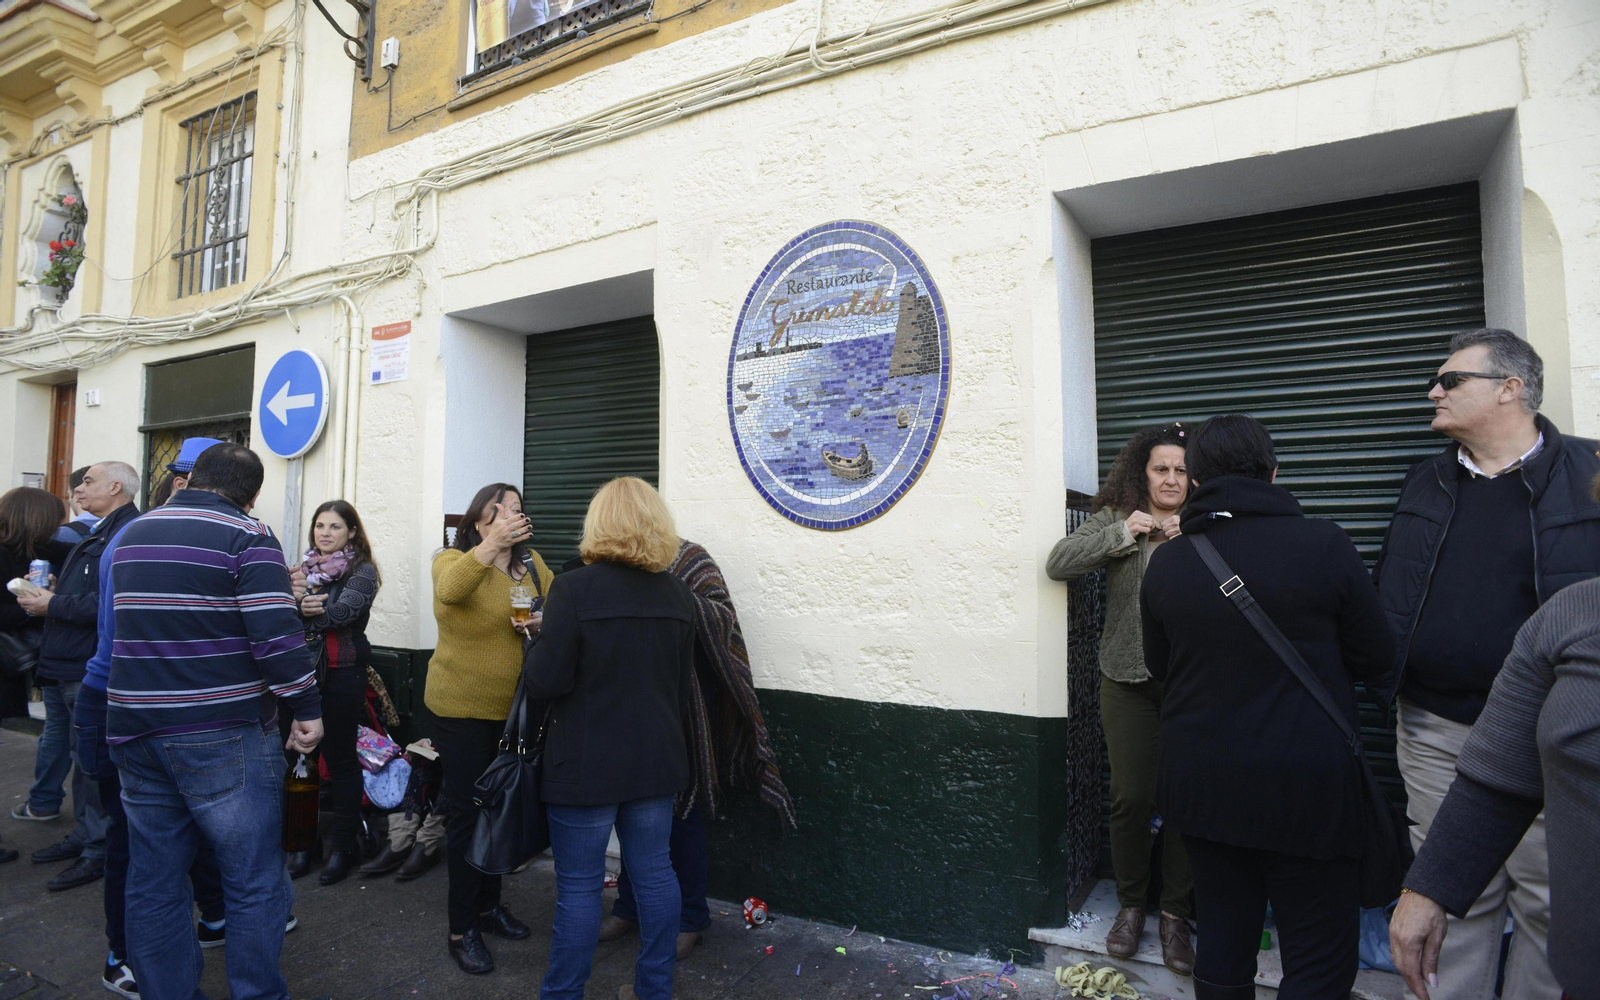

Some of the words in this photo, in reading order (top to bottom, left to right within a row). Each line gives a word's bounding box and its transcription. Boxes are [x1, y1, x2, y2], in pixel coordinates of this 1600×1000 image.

[786, 269, 874, 295] Restaurante
[767, 286, 895, 347] Grimaldi
[86, 391, 96, 404] 10
